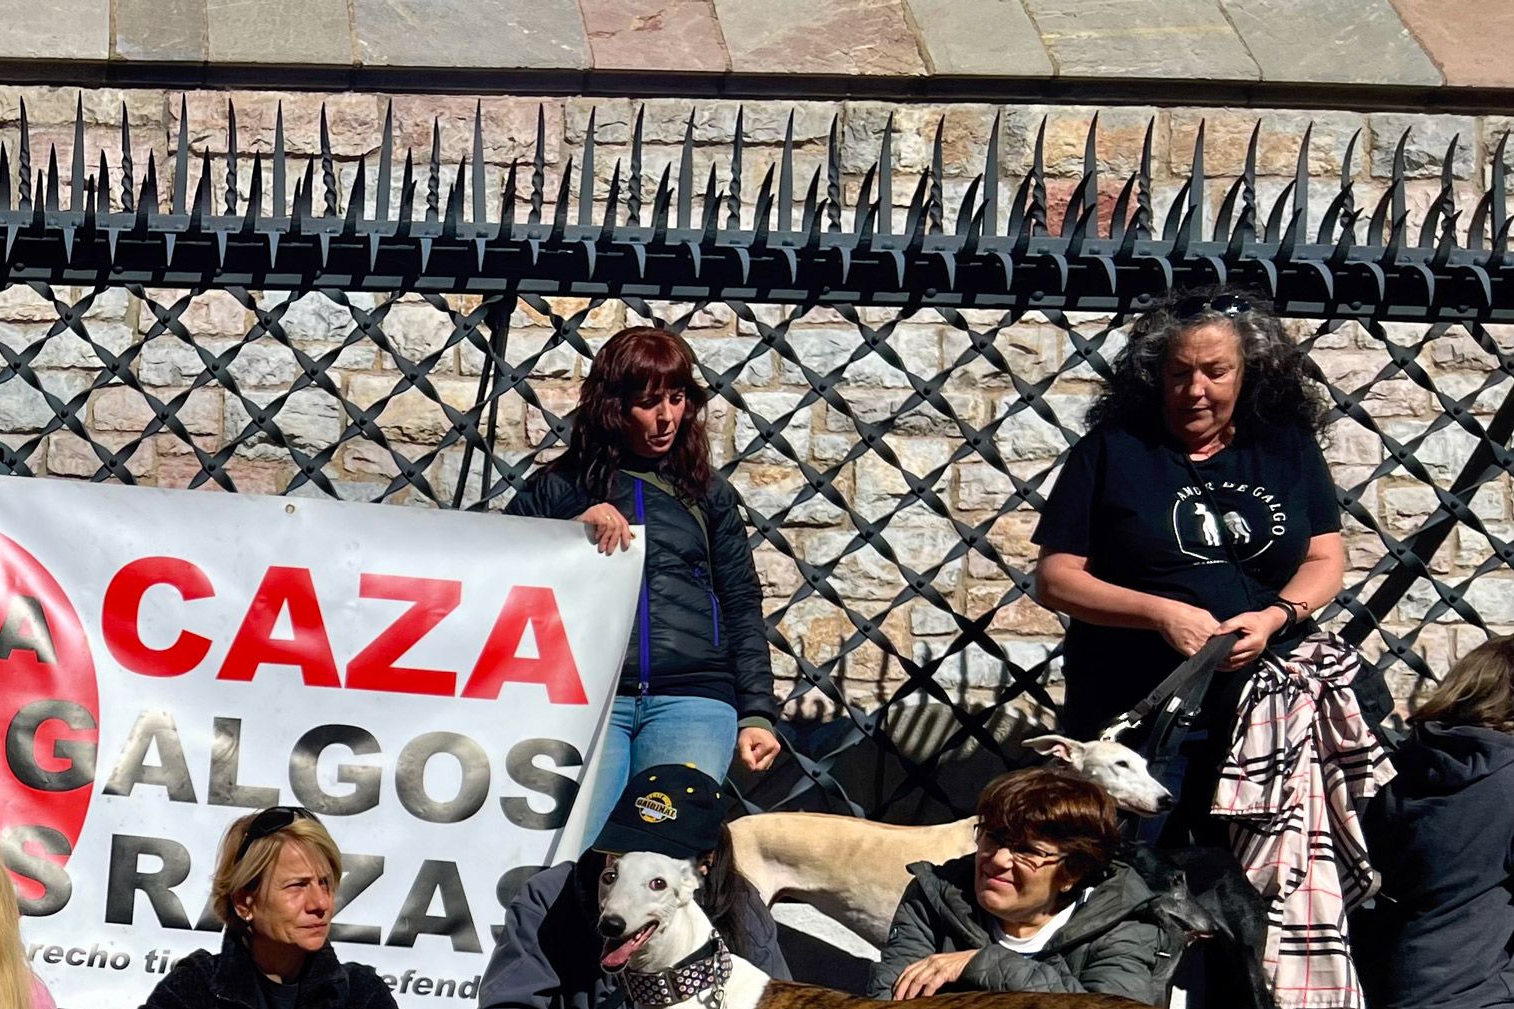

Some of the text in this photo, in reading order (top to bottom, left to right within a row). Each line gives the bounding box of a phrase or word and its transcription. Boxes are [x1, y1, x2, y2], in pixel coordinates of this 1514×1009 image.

[1176, 482, 1214, 501] AMOR
[1252, 486, 1286, 536] GALGO
[100, 555, 588, 706] CAZA
[4, 698, 584, 831] GALGOS
